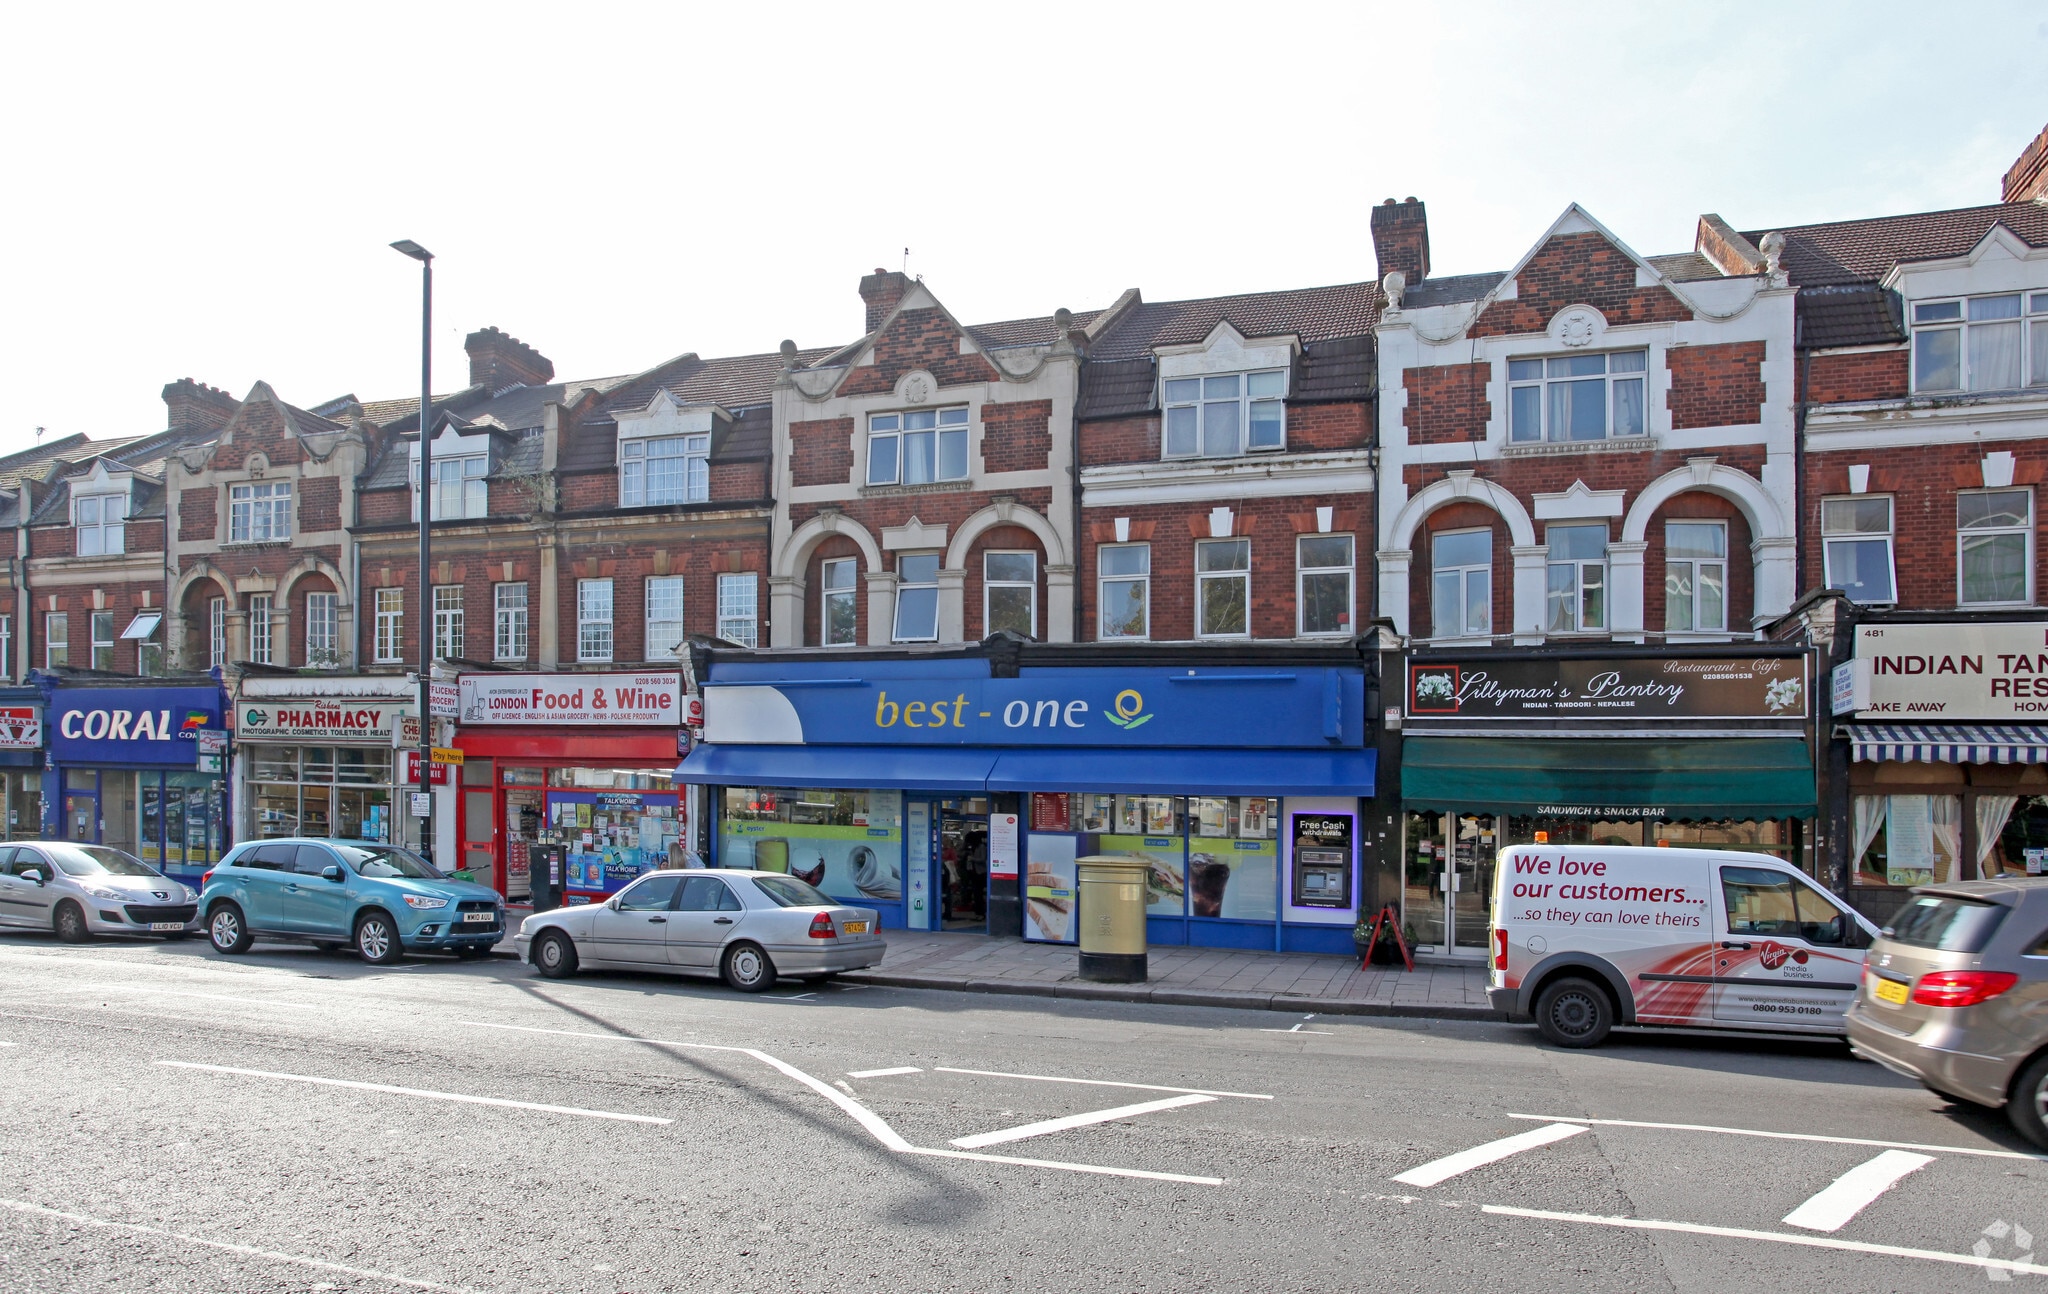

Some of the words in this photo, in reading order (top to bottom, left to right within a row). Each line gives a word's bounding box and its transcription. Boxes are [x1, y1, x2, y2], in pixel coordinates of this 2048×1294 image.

[1663, 660, 1736, 673] Restaurant
[1751, 658, 1782, 675] Cafe
[1874, 655, 1983, 675] INDIAN
[435, 687, 460, 697] LICENCE
[1445, 672, 1571, 706] Lillyman's
[1580, 671, 1684, 705] Pantry
[1991, 678, 2048, 698] RES
[488, 698, 528, 710] LONDON
[532, 688, 583, 710] Food
[592, 688, 608, 710] &
[615, 688, 672, 710] Wine
[1868, 702, 1901, 712] AKE
[1906, 702, 1947, 712] AWAY
[875, 691, 970, 728] best
[1003, 699, 1089, 728] one
[61, 710, 171, 741] CORAL
[277, 710, 381, 728] PHARMACY
[242, 728, 289, 736] PHOTOGRAPHIC
[370, 729, 392, 737] HEALT
[433, 751, 445, 762] Pay
[447, 752, 463, 761] here
[1537, 805, 1592, 815] SANDWICH
[1594, 807, 1601, 815] &
[1603, 806, 1640, 816] SNACK
[1642, 807, 1665, 816] BAR
[1300, 820, 1320, 829] Free
[1322, 821, 1345, 830] Cash
[1302, 829, 1342, 837] withdrawals
[1514, 855, 1551, 874] We
[1558, 856, 1607, 876] love
[1513, 883, 1553, 898] our
[1559, 882, 1705, 904] customers...
[1513, 909, 1542, 921] ...so
[1547, 907, 1581, 925] they
[1585, 911, 1613, 923] can
[1618, 910, 1650, 925] love
[1655, 911, 1700, 927] theirs
[1761, 943, 1787, 966] Virgin
[1783, 971, 1814, 979] business
[1738, 995, 1837, 1007] www.virginmediabusiness.co.uk
[1753, 1004, 1776, 1012] 0800
[1778, 1005, 1796, 1013] 953
[1798, 1006, 1822, 1015] 0180
